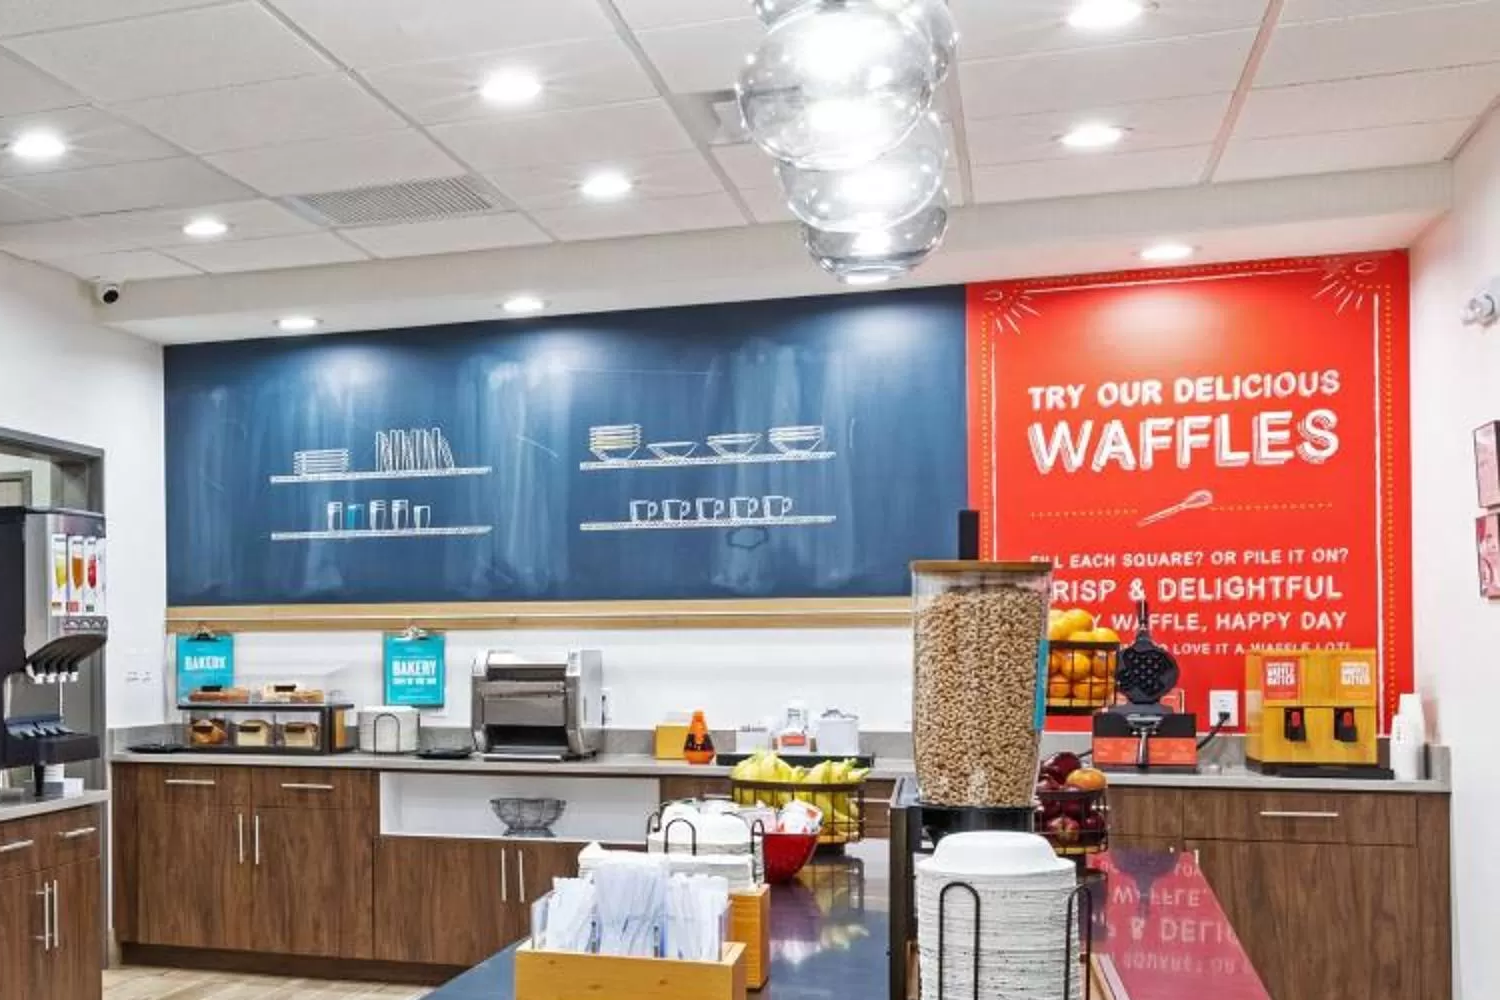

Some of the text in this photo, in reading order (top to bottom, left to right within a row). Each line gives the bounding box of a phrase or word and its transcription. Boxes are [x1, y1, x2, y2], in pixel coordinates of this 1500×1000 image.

[1027, 368, 1341, 412] TRY OUR DELICIOUS
[1027, 408, 1340, 475] WAFFLES
[1070, 553, 1116, 569] EACH
[1122, 551, 1203, 568] SQUARE?
[1210, 550, 1237, 566] OR
[1243, 549, 1282, 565] PILE
[1288, 549, 1305, 564] IT
[1311, 548, 1349, 564] ON?
[1051, 575, 1343, 602] RISP & DELIGHTFUL
[1215, 611, 1291, 631] HAPPY
[1301, 611, 1347, 630] DAY
[1173, 643, 1211, 655] LOVE
[1215, 643, 1228, 655] IT
[1234, 643, 1245, 655] A
[184, 655, 227, 671] BAKERY
[392, 659, 436, 677] BAKERY
